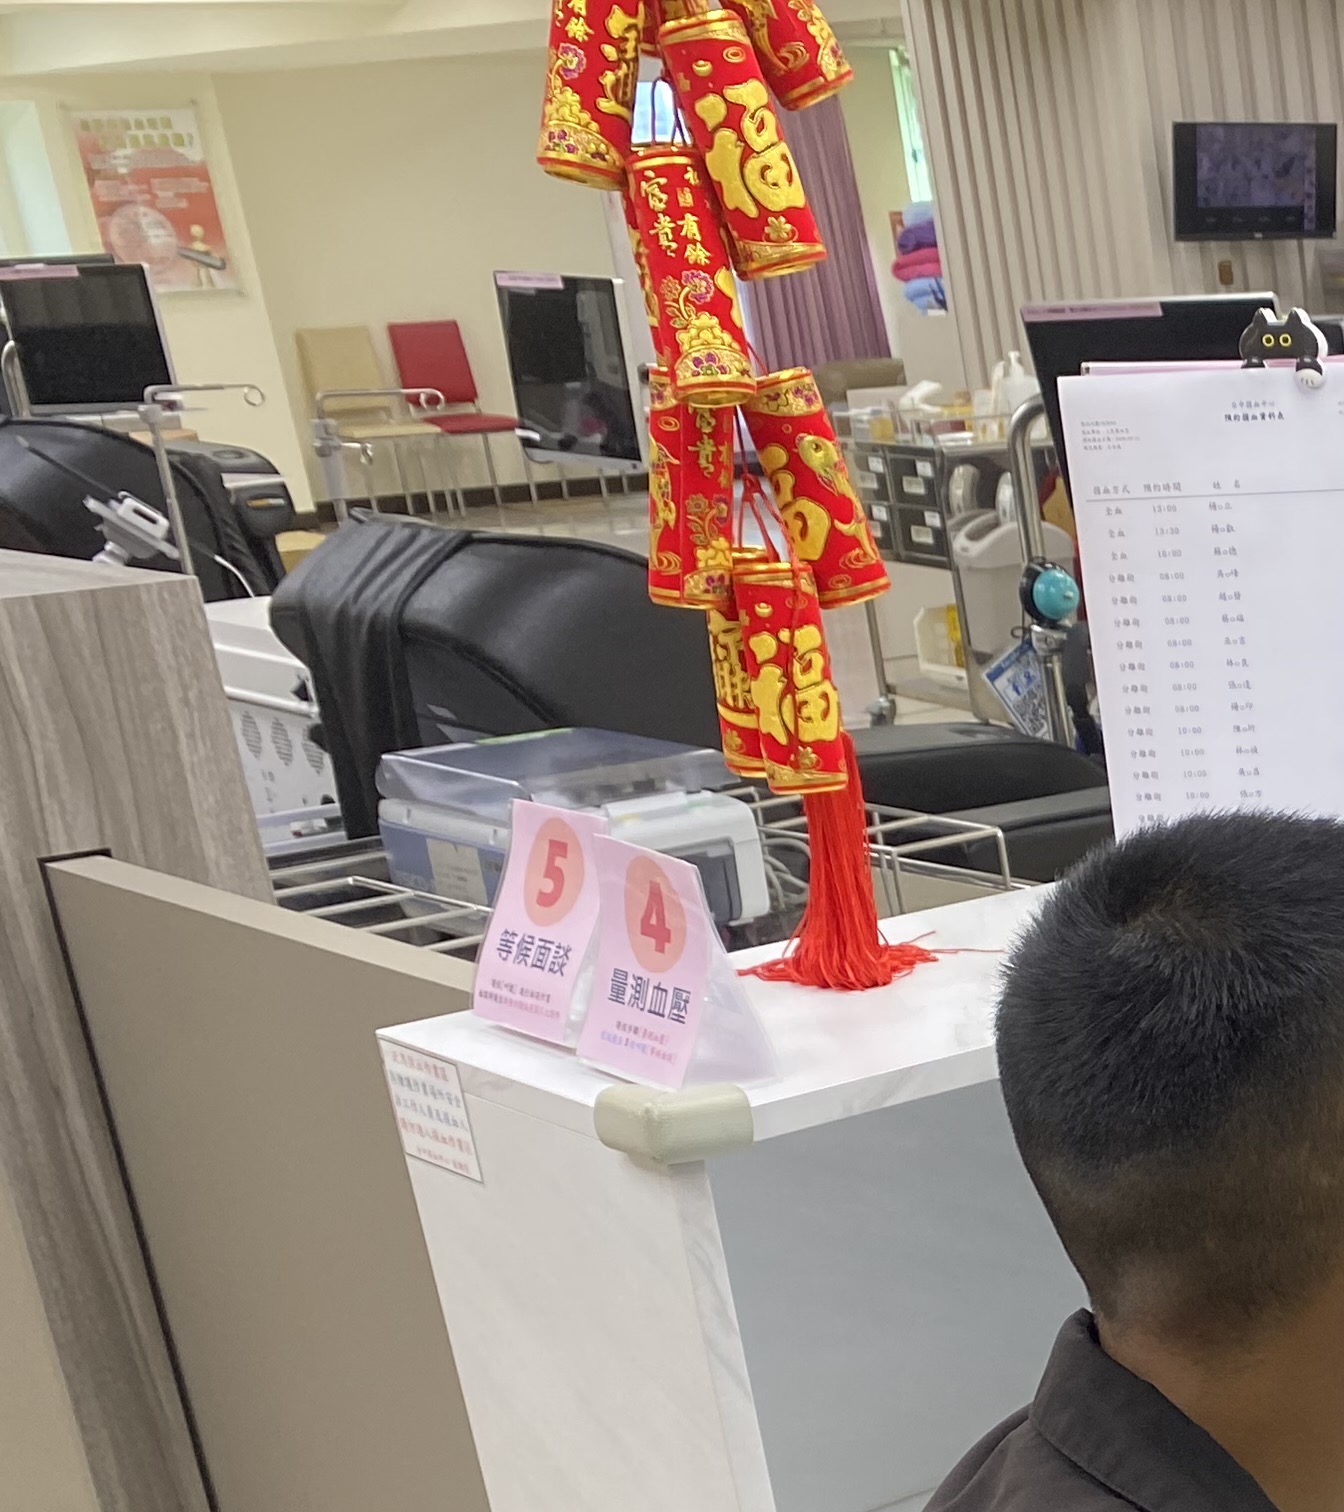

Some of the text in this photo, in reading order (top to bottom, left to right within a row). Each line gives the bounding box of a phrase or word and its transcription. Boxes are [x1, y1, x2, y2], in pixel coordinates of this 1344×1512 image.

[694, 79, 806, 218] 福
[536, 838, 569, 908] 5
[640, 879, 672, 955] 4
[496, 928, 573, 977] 等候面談
[608, 967, 692, 1025] 量測血壓
